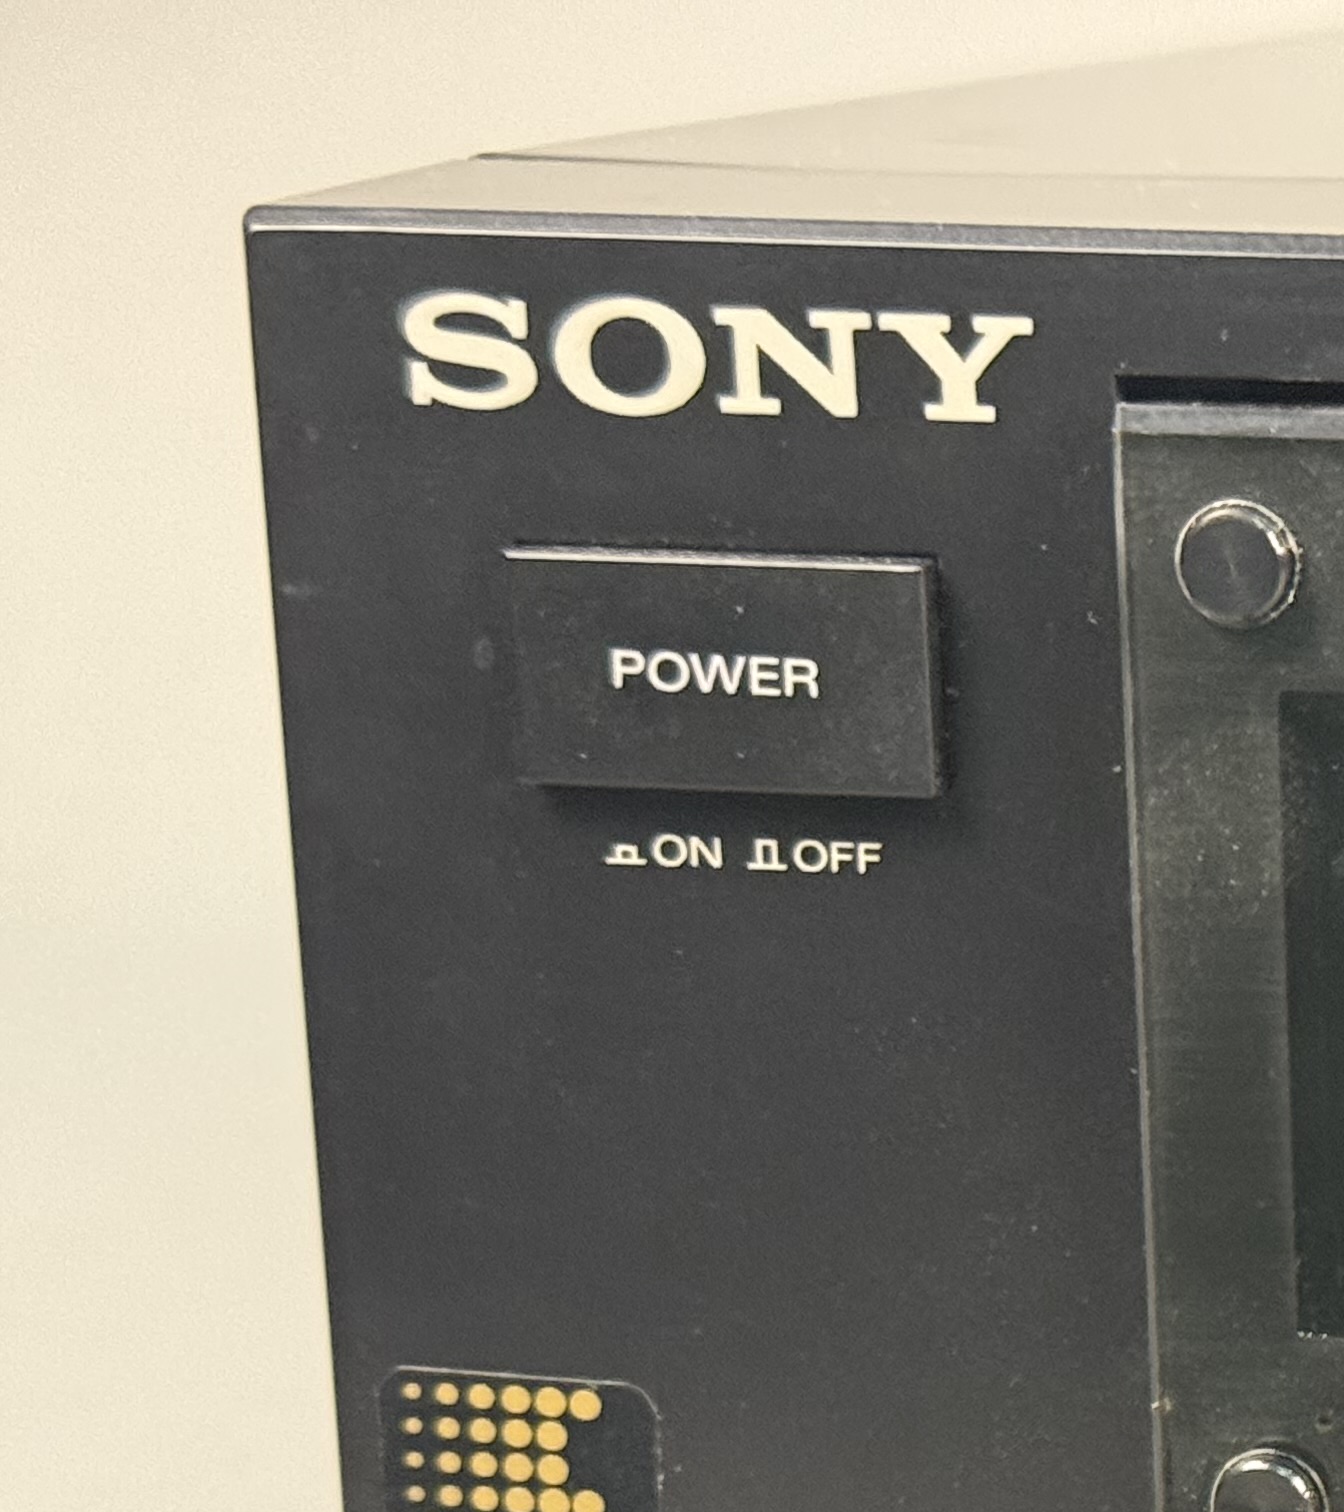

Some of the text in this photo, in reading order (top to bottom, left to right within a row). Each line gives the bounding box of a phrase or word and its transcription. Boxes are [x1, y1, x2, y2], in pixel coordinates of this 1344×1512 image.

[401, 290, 1035, 424] SONY
[609, 647, 820, 700] POWER
[650, 832, 884, 876] ON OFF
